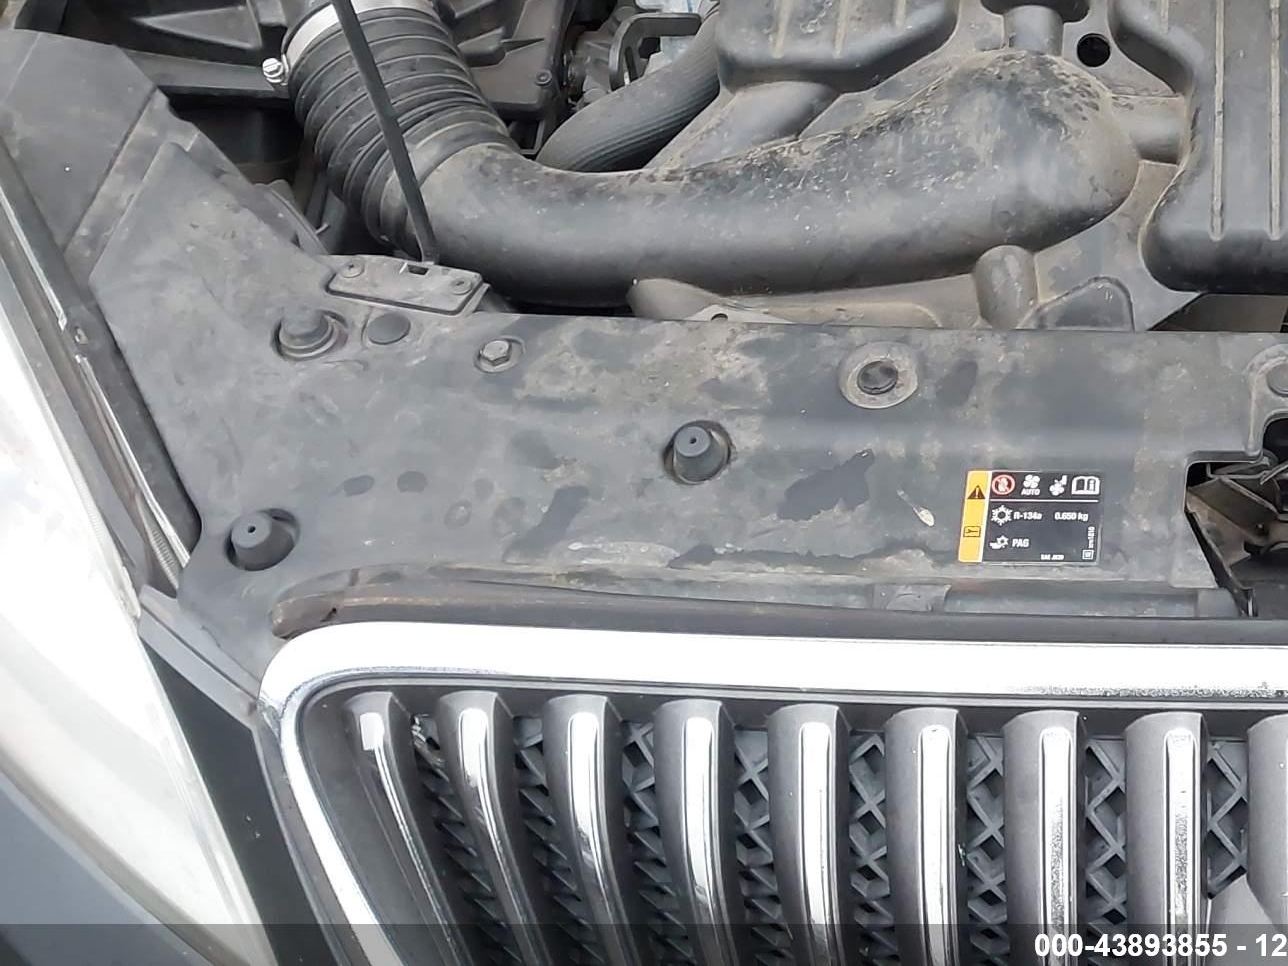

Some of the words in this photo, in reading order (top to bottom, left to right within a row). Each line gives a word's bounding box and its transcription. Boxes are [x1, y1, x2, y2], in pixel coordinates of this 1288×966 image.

[1021, 488, 1041, 496] AUTO
[1013, 511, 1042, 520] R-134a
[1054, 511, 1077, 521] 0.650
[1077, 511, 1089, 522] kg
[1012, 538, 1030, 548] PAG
